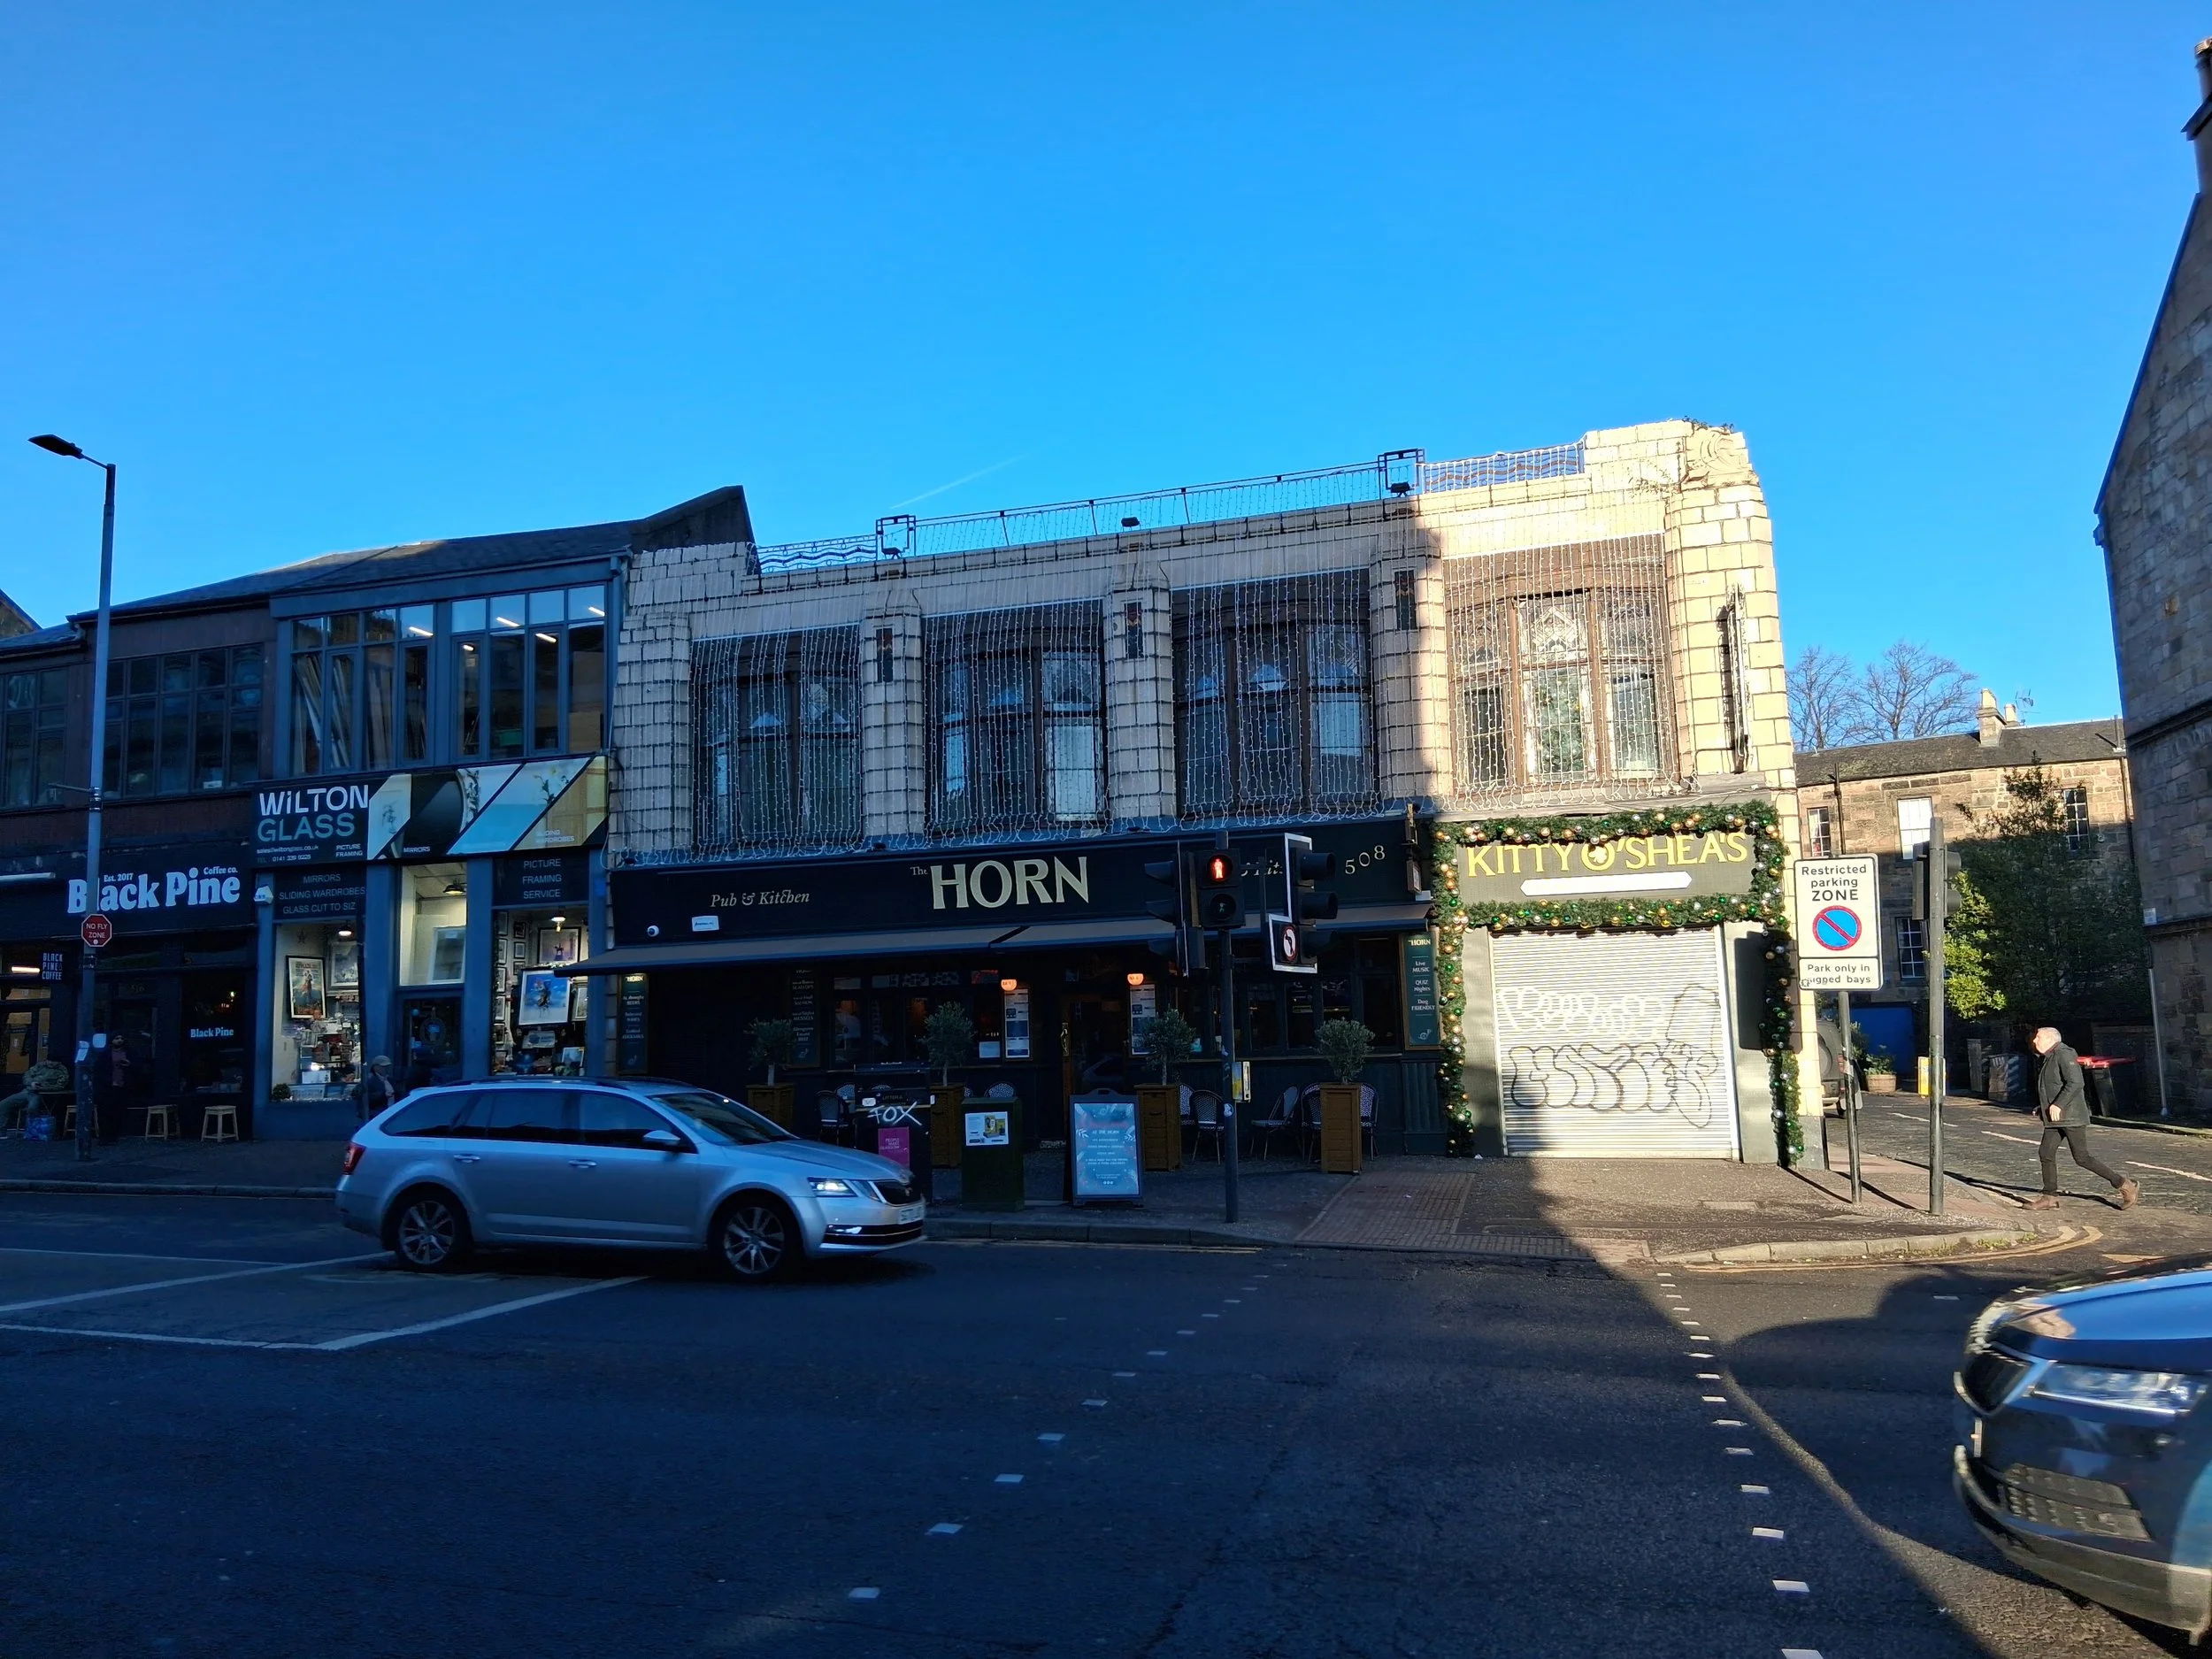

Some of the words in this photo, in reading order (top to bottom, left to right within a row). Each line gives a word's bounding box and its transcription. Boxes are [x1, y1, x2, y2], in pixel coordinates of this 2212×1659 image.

[257, 812, 355, 841] GLASS
[524, 858, 561, 869] PICTURE
[1345, 844, 1386, 875] 508
[1467, 843, 1575, 877] KITTY
[204, 866, 227, 875] Coffee
[1801, 864, 1867, 875] Restricted
[117, 872, 134, 881] 2017
[303, 873, 342, 884] MIRRORS
[522, 874, 562, 885] FRAMING
[165, 867, 241, 907] Pine
[910, 865, 928, 876] The
[930, 856, 1089, 910] HORN
[1810, 878, 1858, 888] parking
[279, 891, 311, 900] SLIDING
[312, 887, 365, 898] WARDROBES
[523, 888, 561, 900] SERVICE
[710, 892, 737, 908] Pub
[741, 892, 756, 906] &
[758, 889, 810, 905] Kitchen
[1812, 888, 1859, 902] ZONE
[283, 904, 309, 914] GLASS
[311, 903, 327, 912] CUT
[328, 902, 342, 911] TO
[42, 962, 58, 971] PINE
[1808, 964, 1831, 972] Park
[1834, 964, 1856, 973] only
[42, 971, 63, 980] COFFEE
[1847, 975, 1871, 984] bays
[190, 1027, 214, 1038] Black
[215, 1026, 234, 1037] Pine
[867, 1101, 923, 1126] FOX
